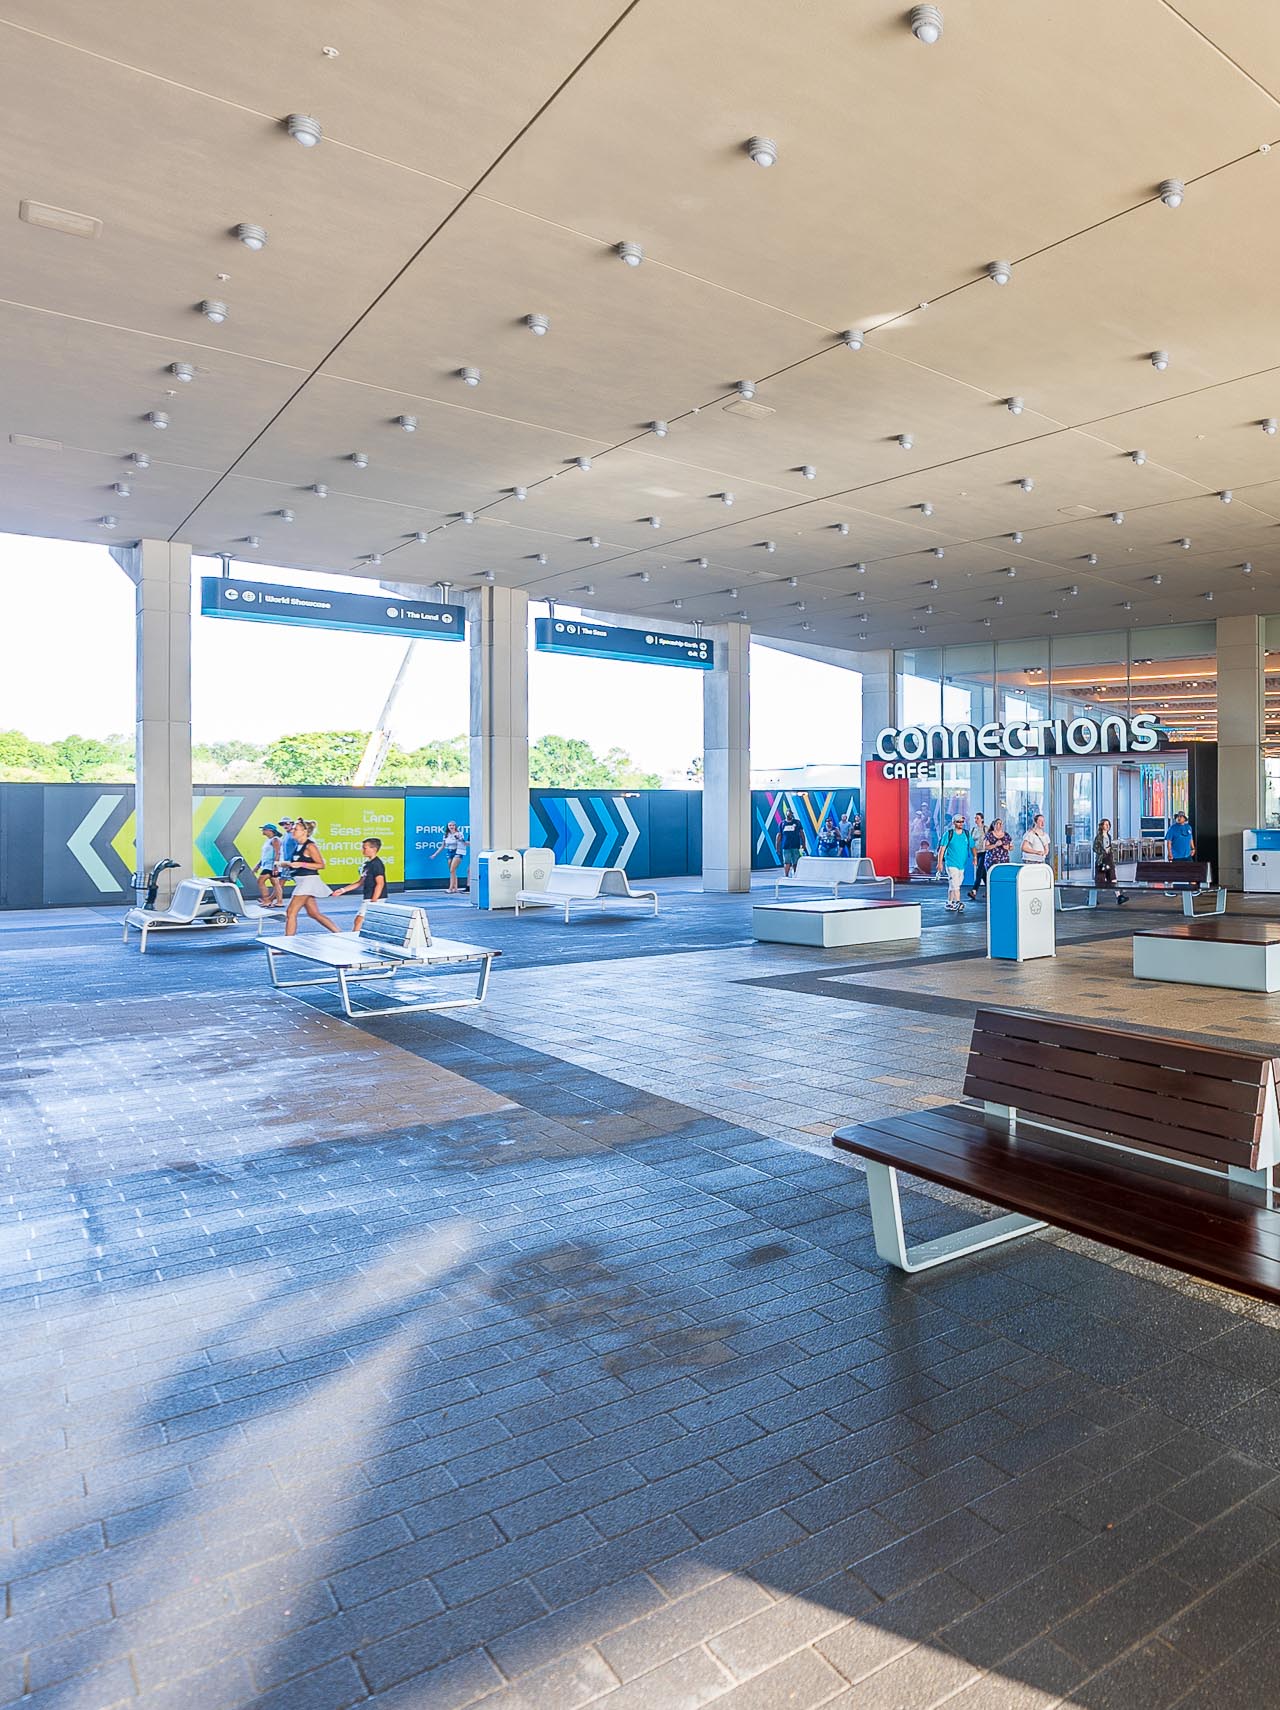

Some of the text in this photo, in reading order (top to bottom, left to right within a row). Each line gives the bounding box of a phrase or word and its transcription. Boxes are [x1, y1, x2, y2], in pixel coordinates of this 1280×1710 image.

[264, 594, 331, 609] World Showcase
[406, 611, 440, 621] The Land
[875, 713, 1160, 762] CONNECTIONS
[362, 814, 395, 823] LAND
[330, 827, 362, 836] SEAS
[416, 825, 445, 834] PARK
[415, 841, 445, 850] SPAC
